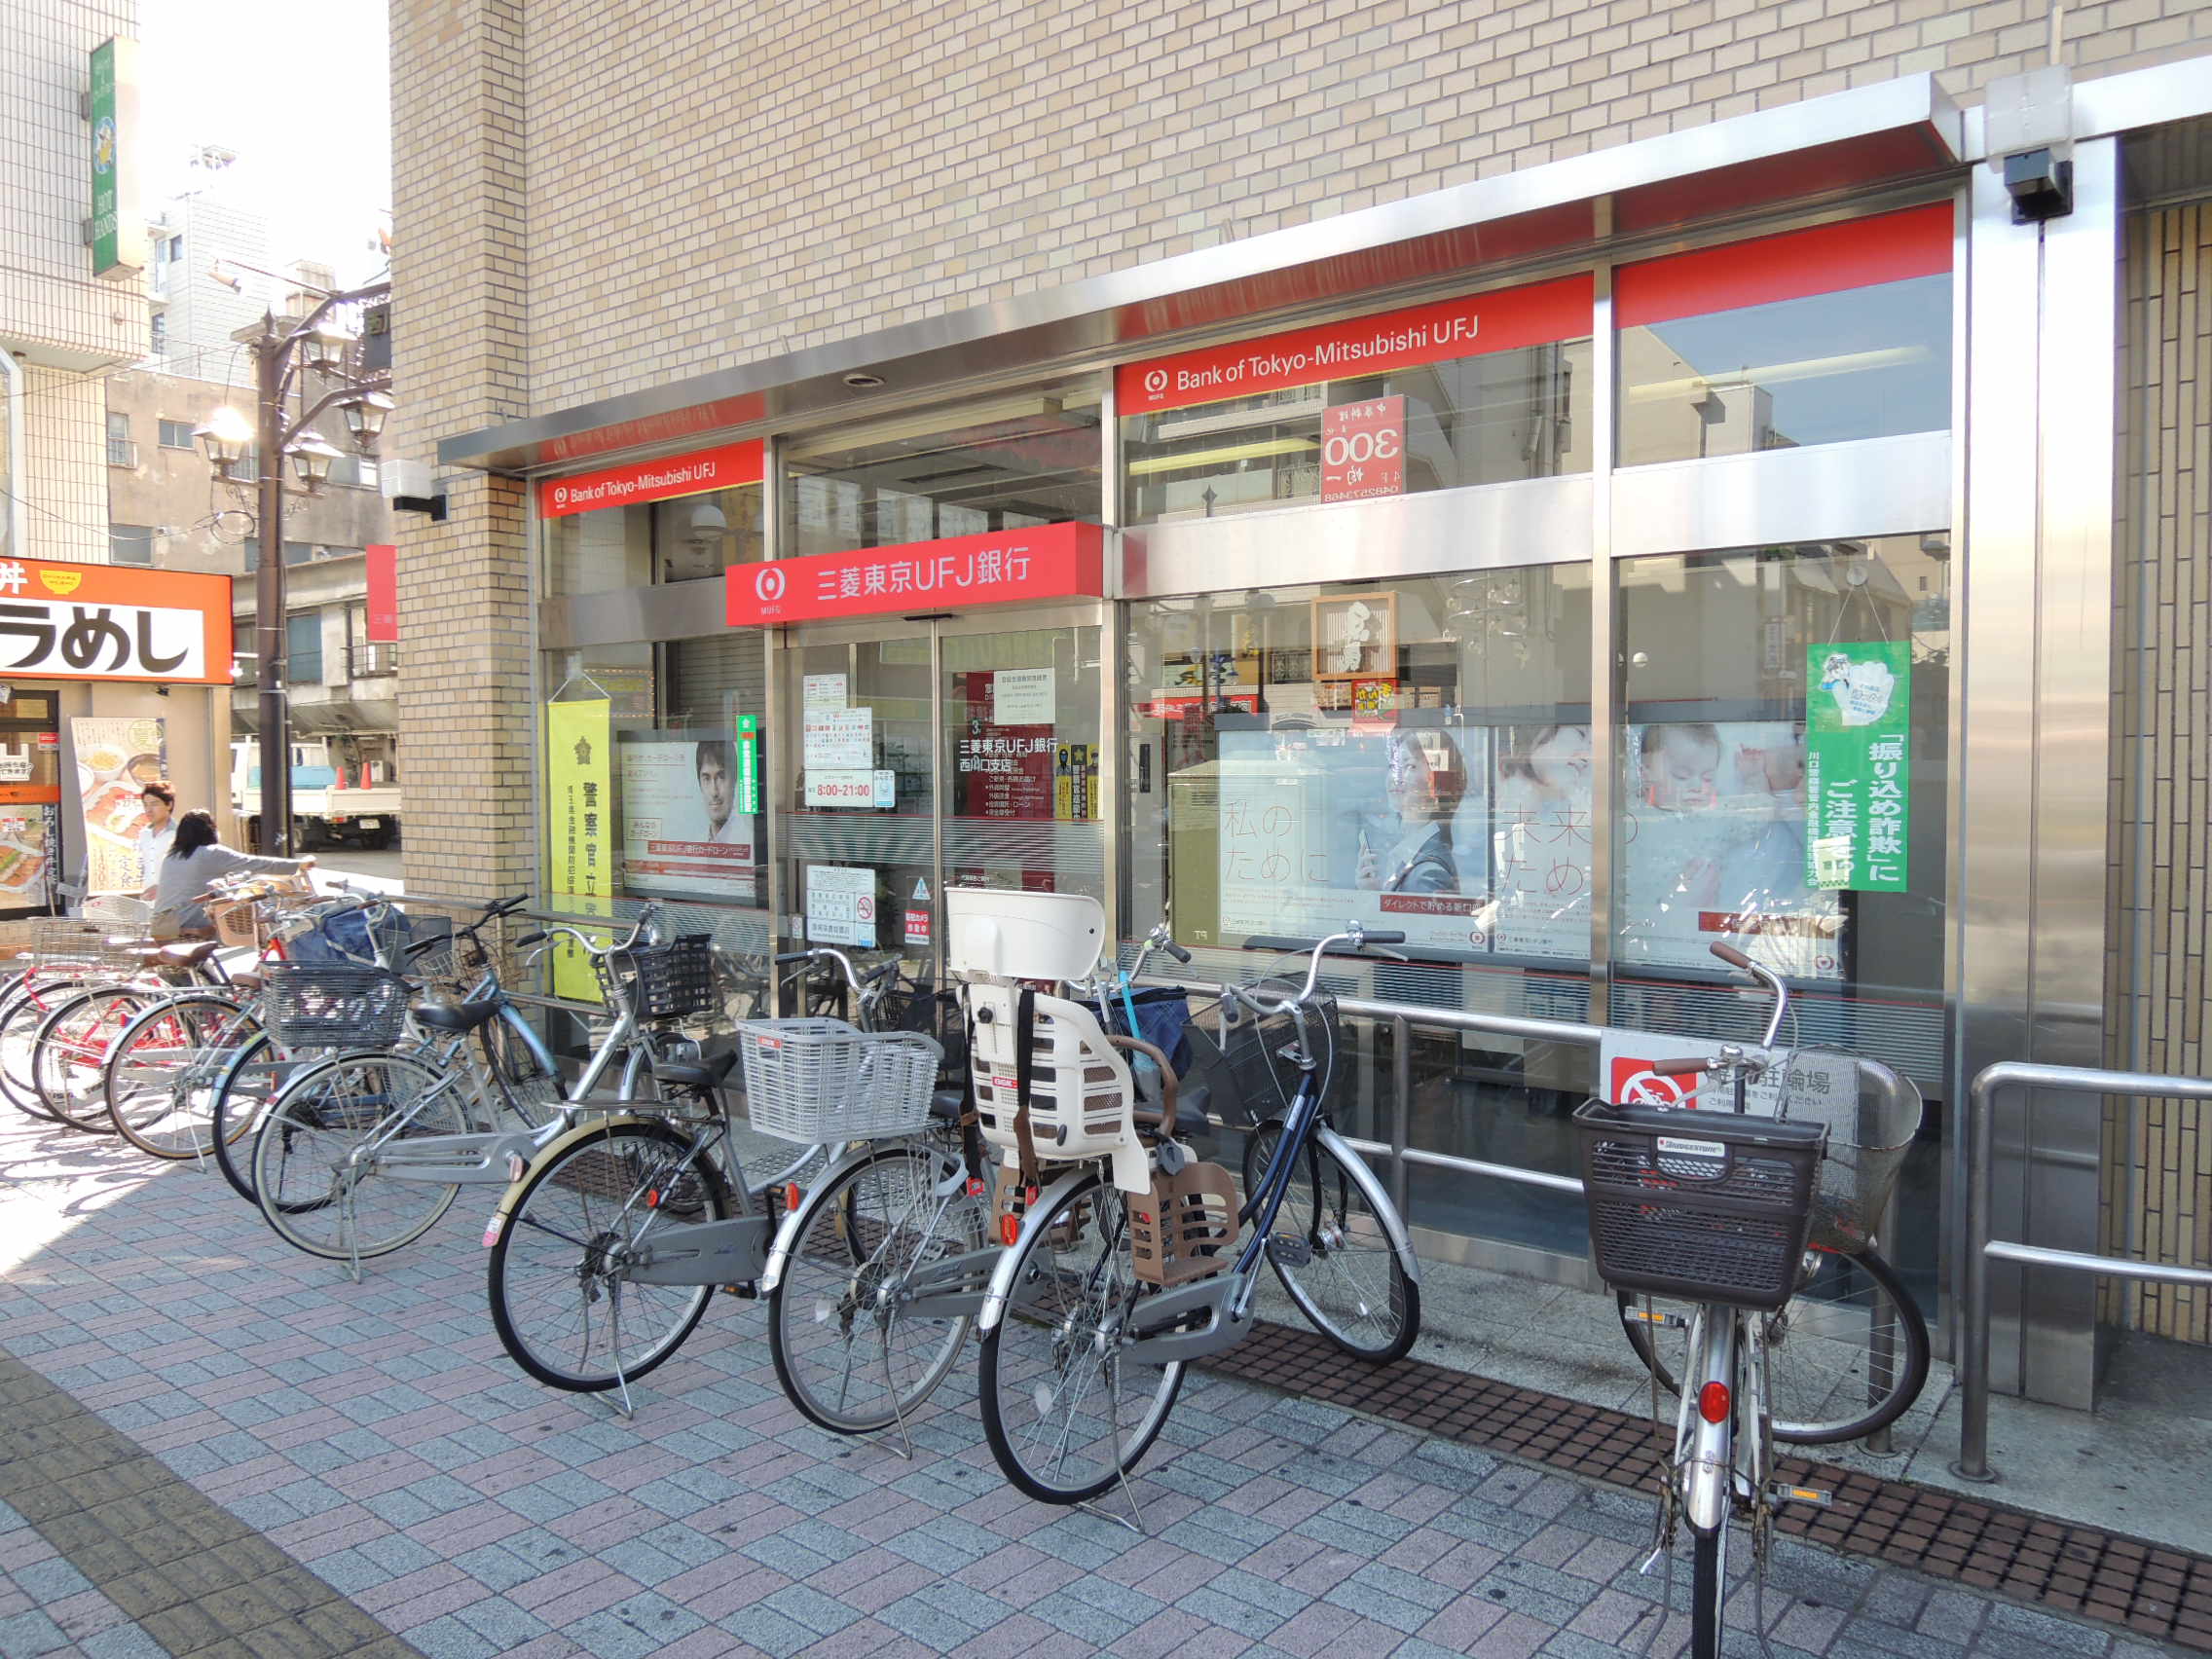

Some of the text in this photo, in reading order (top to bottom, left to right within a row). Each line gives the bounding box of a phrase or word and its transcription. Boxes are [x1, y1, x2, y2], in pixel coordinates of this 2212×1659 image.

[1177, 314, 1480, 390] Bank of Tokyo-Mitsubishi UFJ
[571, 462, 717, 503] Bank of Tokyo-Mitsubishi UFJ
[817, 546, 1031, 601] 三菱東京UFJ銀行
[959, 738, 1058, 755] 三菱東京UFJ銀行
[960, 757, 1012, 772] 西川口支店
[818, 785, 869, 796] 8:00-21:00
[1224, 798, 1292, 839] 私の
[1224, 848, 1330, 881] ために
